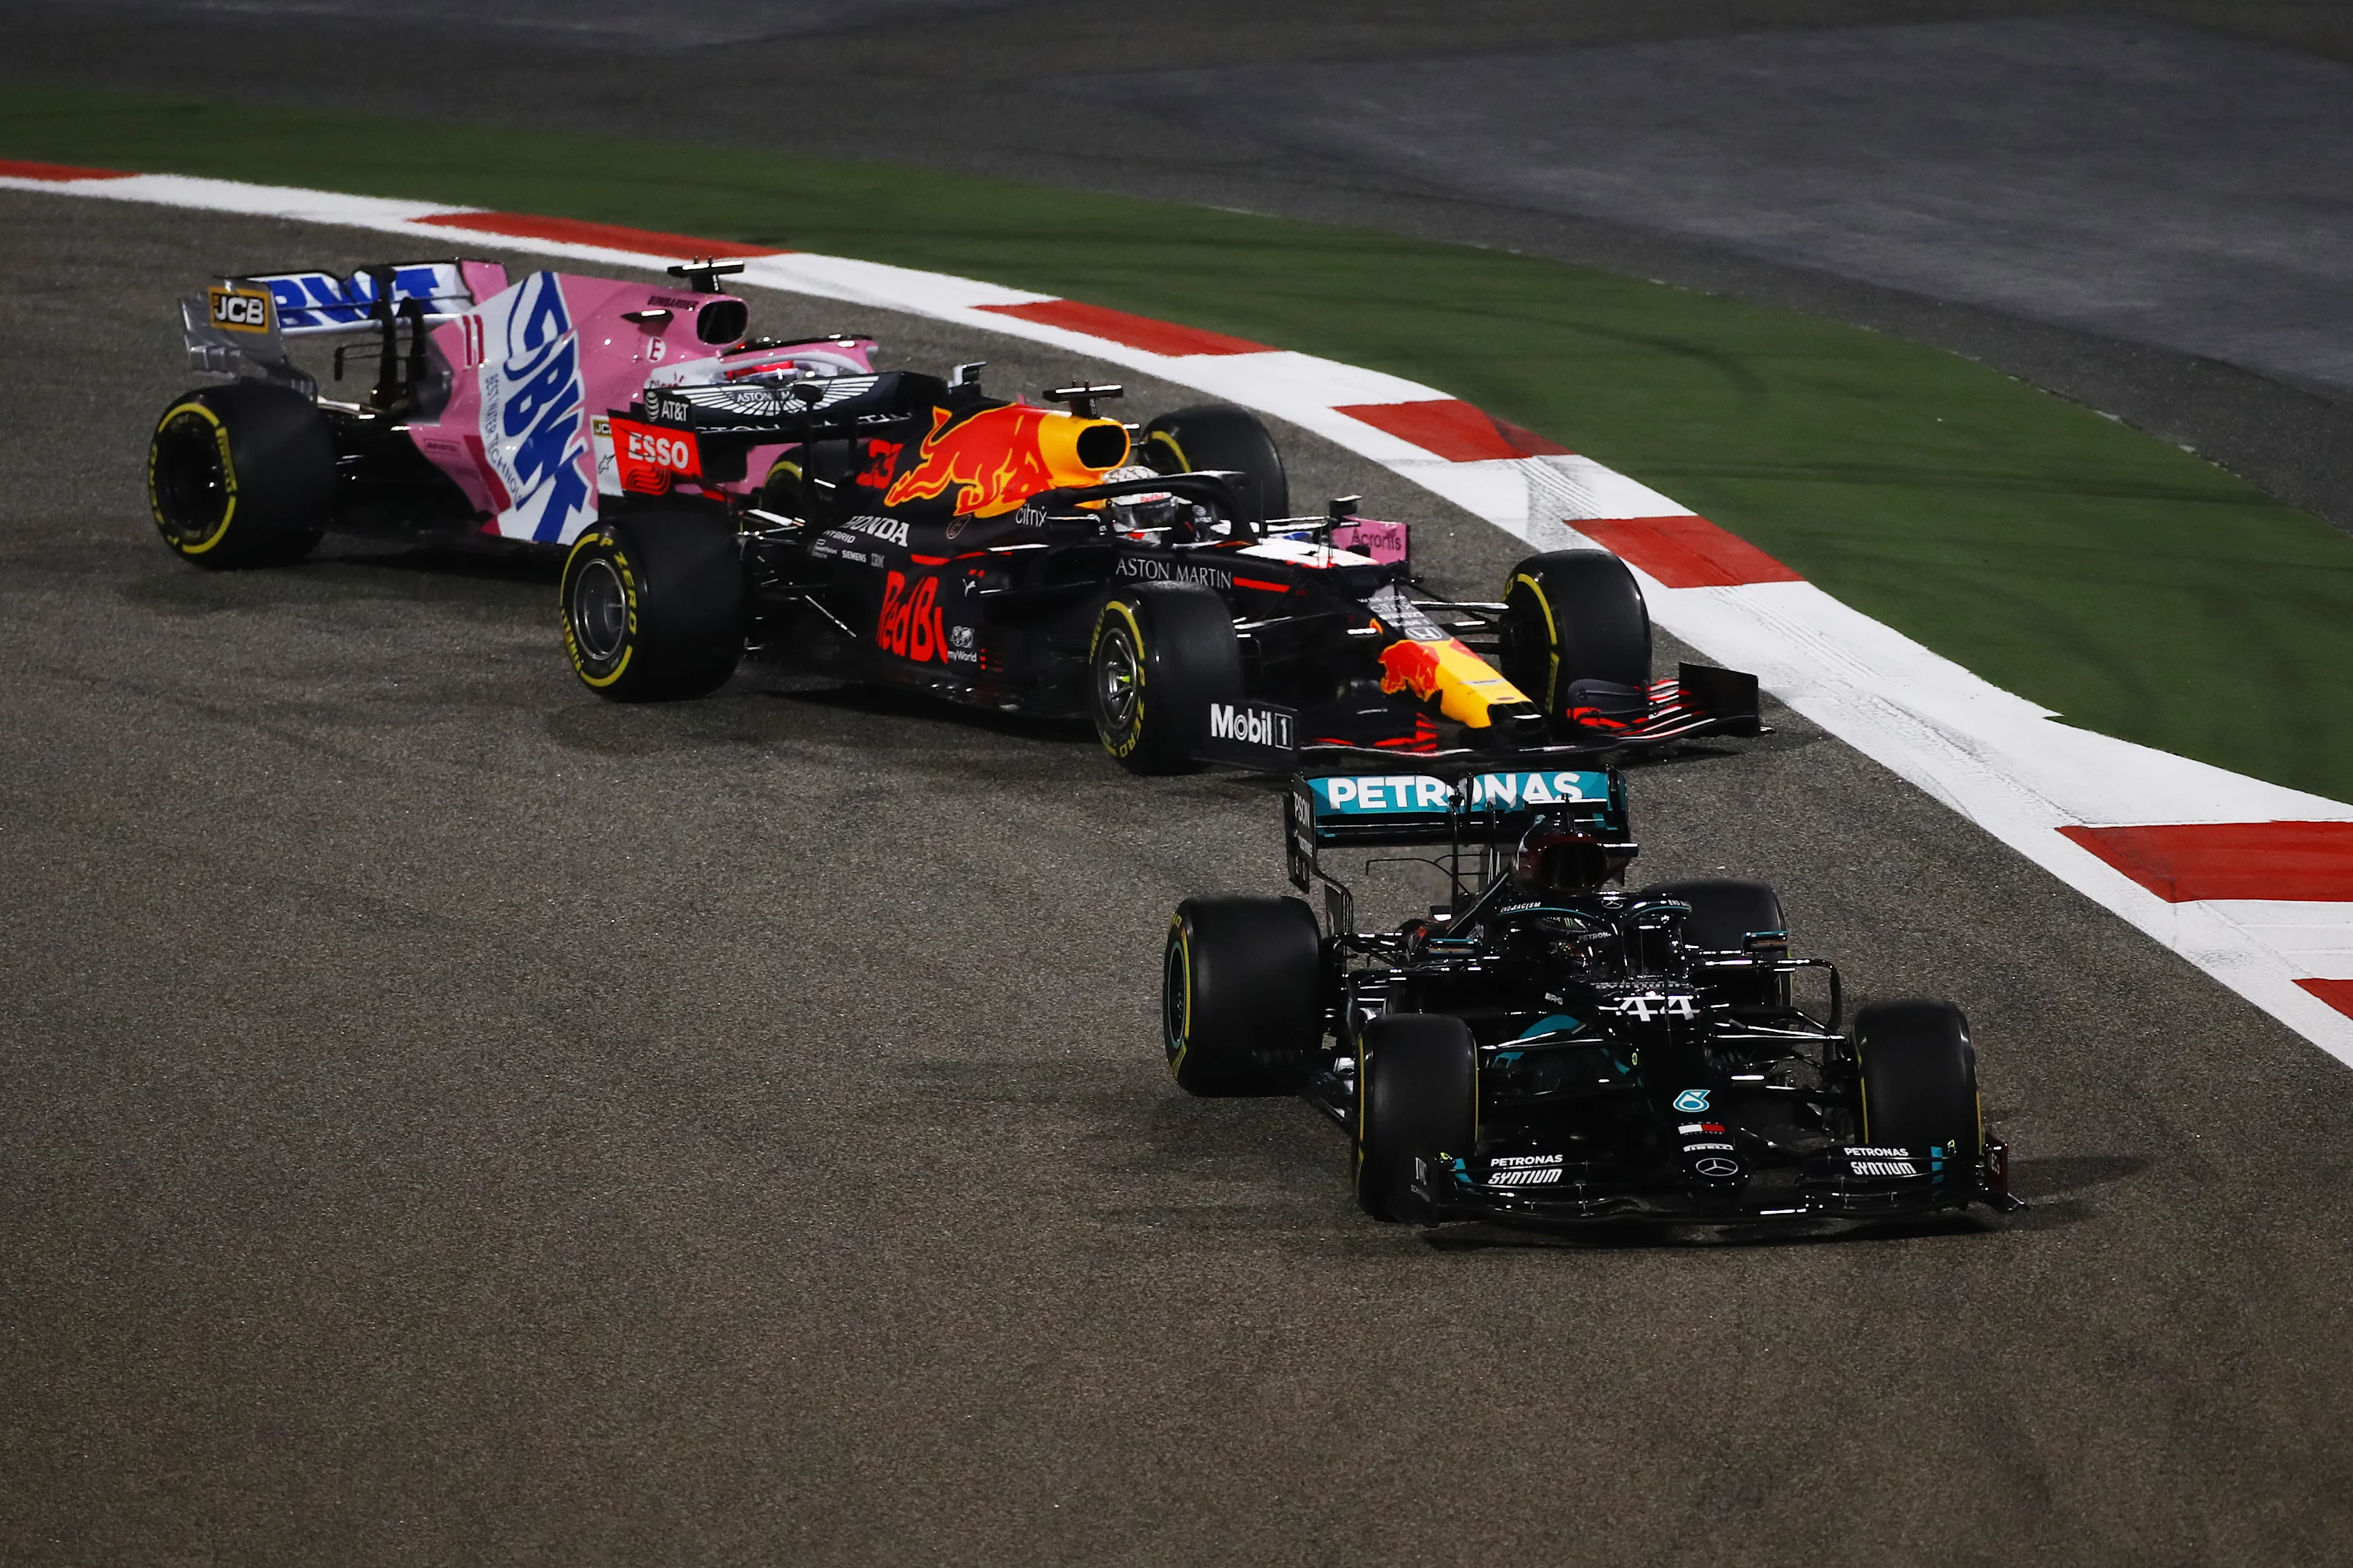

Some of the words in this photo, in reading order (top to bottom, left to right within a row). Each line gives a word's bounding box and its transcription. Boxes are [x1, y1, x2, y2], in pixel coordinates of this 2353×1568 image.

[214, 295, 264, 325] JCB
[463, 313, 484, 365] 11
[737, 392, 773, 403] ASTON
[661, 400, 690, 422] AT&T
[594, 422, 612, 435] JC
[628, 431, 690, 470] ESSO
[856, 438, 905, 490] 33
[1015, 503, 1047, 528] citrix
[822, 528, 857, 544] HYBRID
[838, 515, 911, 548] HONDA
[1351, 526, 1402, 551] Acronis
[841, 549, 867, 563] SIEMENS
[871, 552, 885, 569] IBM
[1115, 557, 1170, 581] ASTON
[1176, 564, 1232, 589] MARTIN
[611, 551, 638, 635] ZERO
[1210, 703, 1273, 747] Mobil
[1327, 772, 1583, 810] PETRONAS
[1511, 902, 1541, 911] RACISM
[1619, 996, 1701, 1022] 44
[1490, 1154, 1564, 1167] PETRONAS
[1842, 1146, 1909, 1157] PETRONAS
[1487, 1168, 1563, 1184] SYNTIUM
[1849, 1161, 1917, 1175] SYNTIUM
